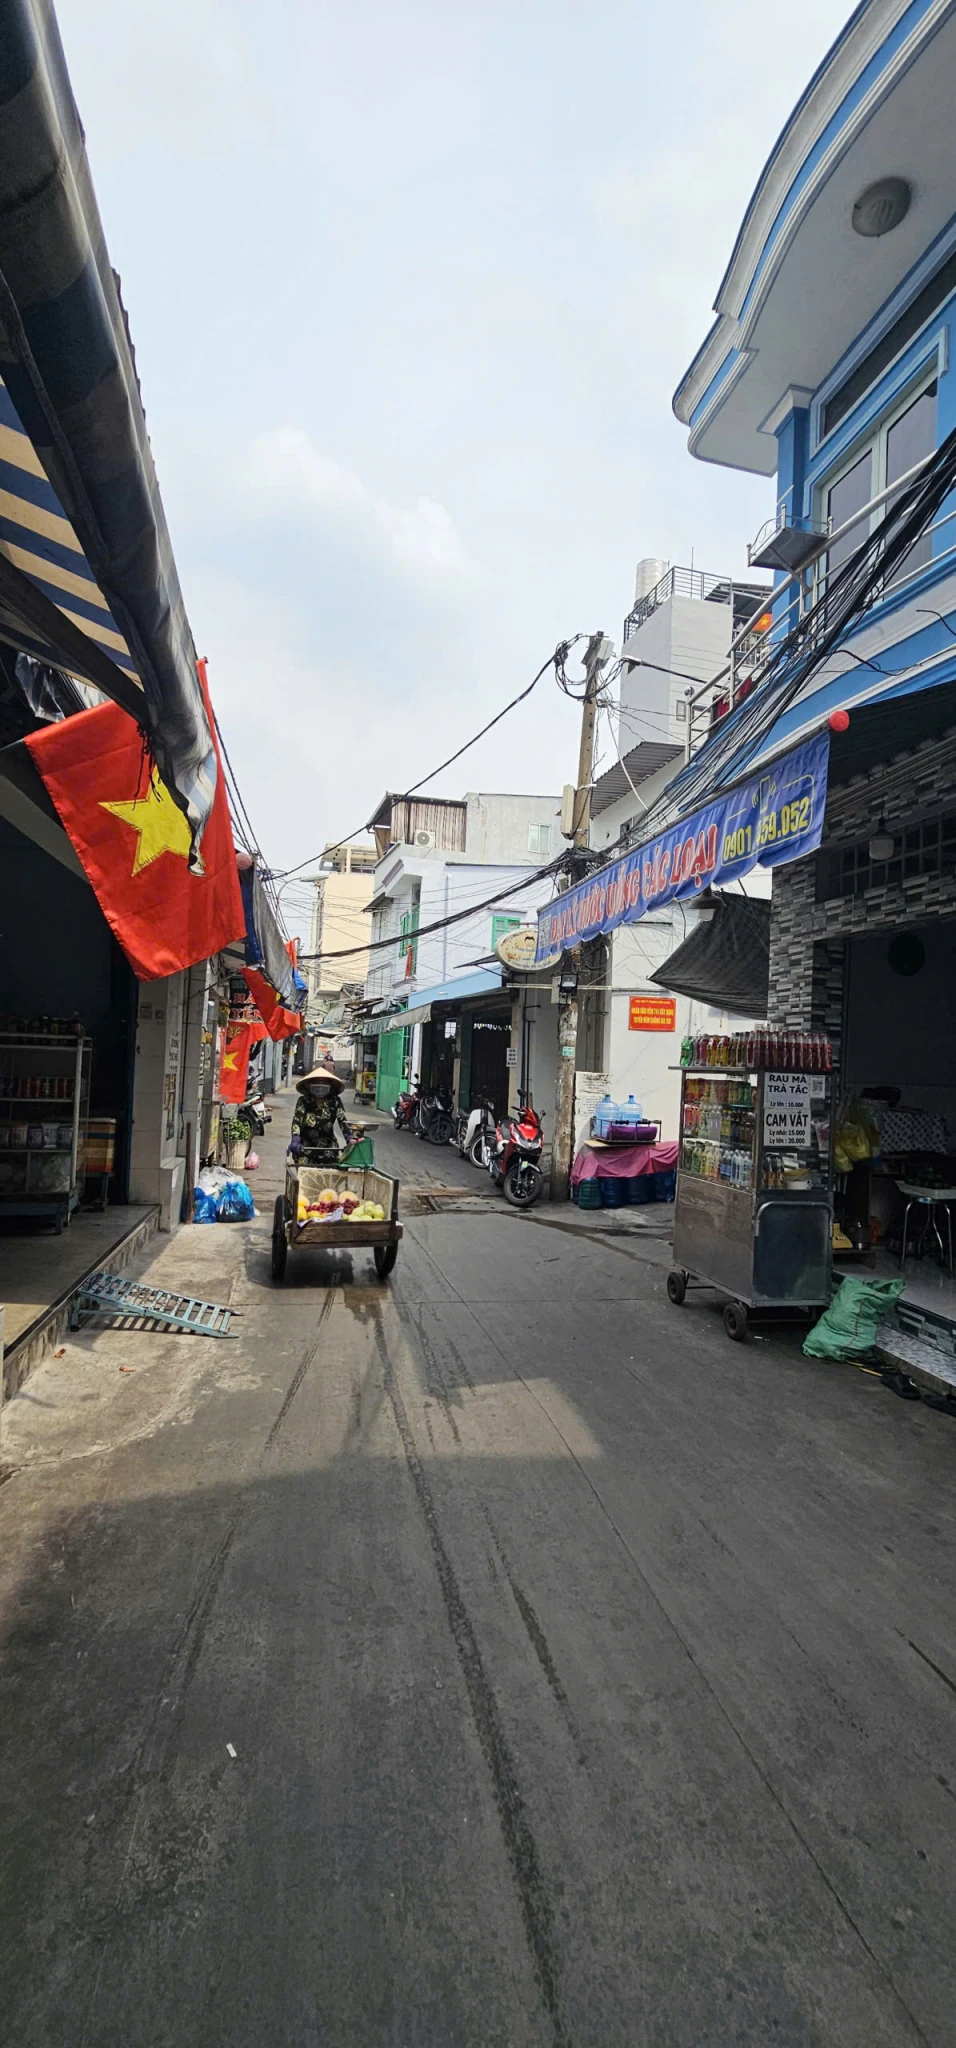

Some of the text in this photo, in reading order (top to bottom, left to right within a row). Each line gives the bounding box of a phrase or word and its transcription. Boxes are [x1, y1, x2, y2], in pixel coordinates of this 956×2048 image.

[643, 845, 671, 900] CÁC
[669, 824, 718, 888] LOẠI
[769, 1073, 807, 1083] RAU MÁ
[767, 1084, 787, 1093] TRÀ
[766, 1110, 808, 1127] CAM VẮT
[769, 1129, 776, 1137] Ly
